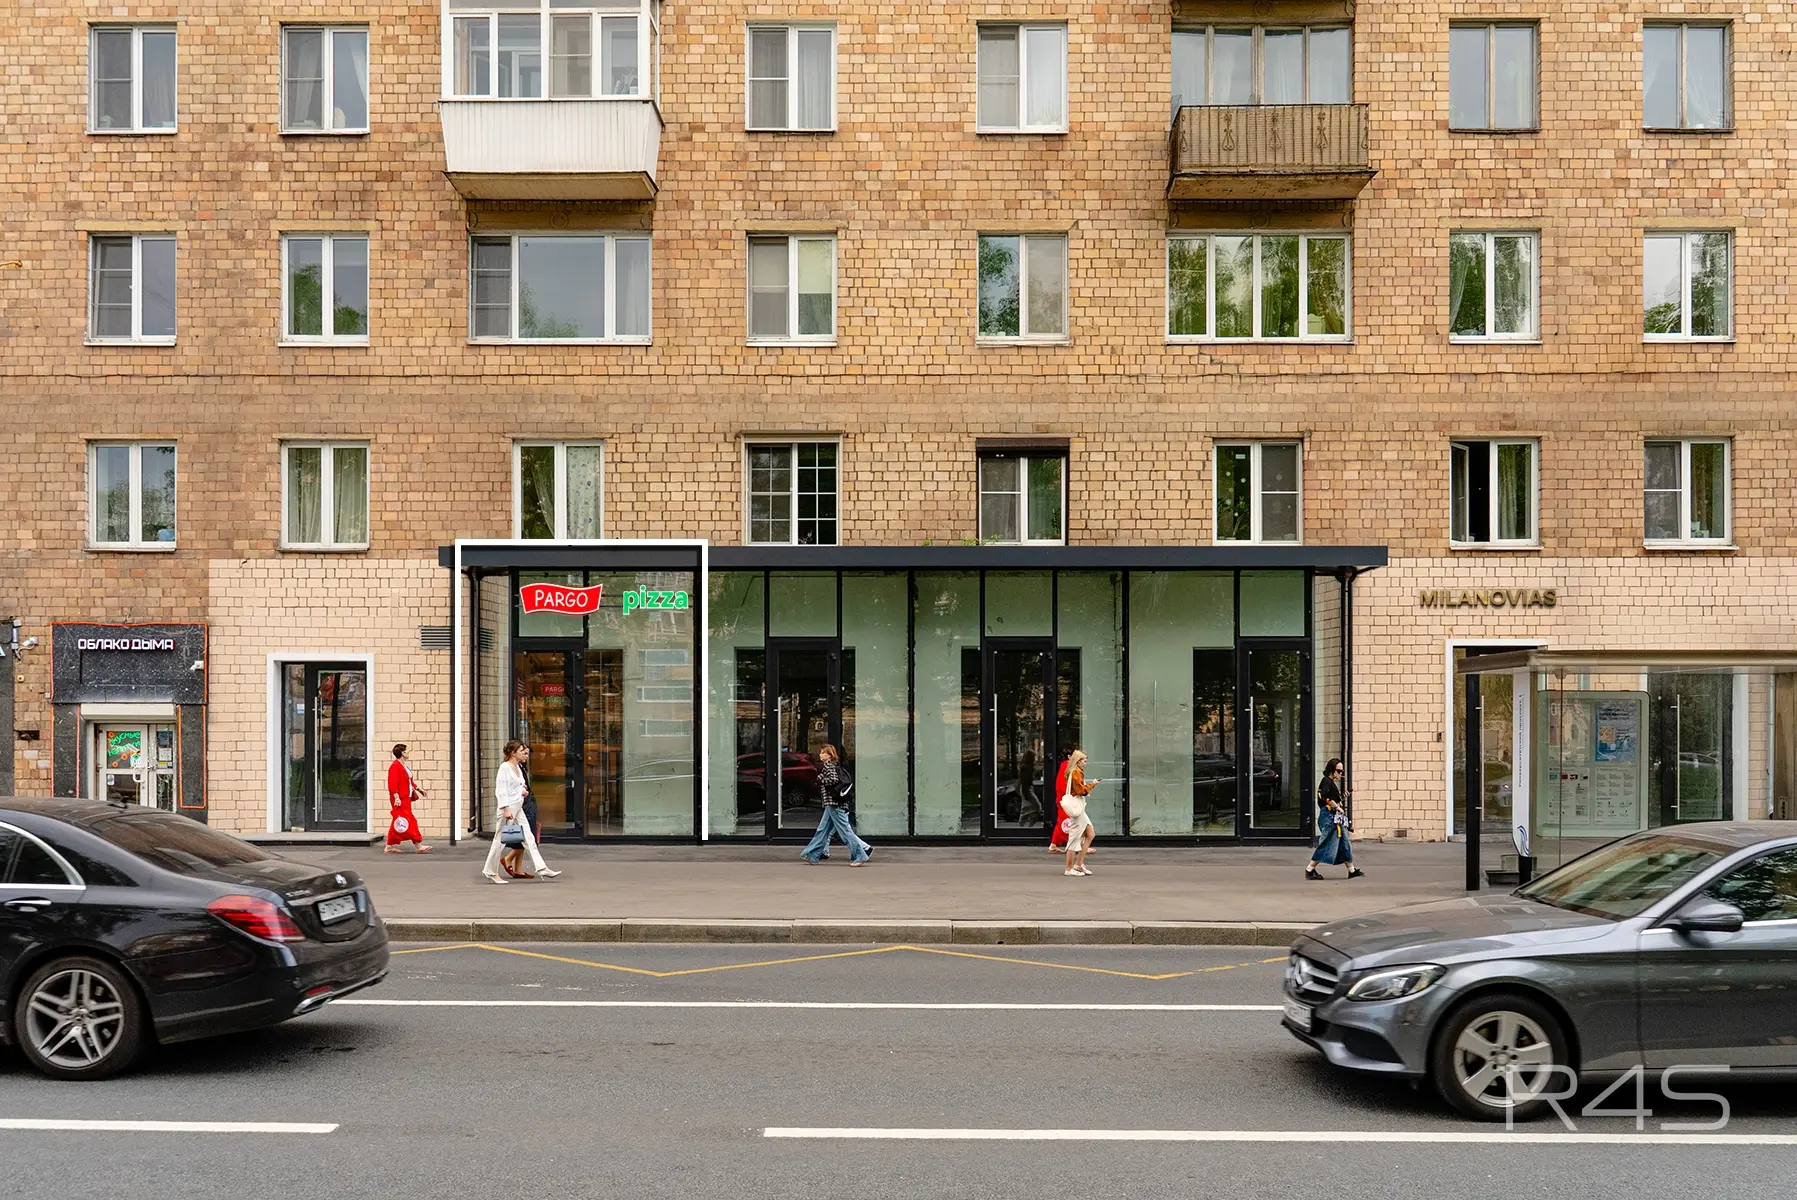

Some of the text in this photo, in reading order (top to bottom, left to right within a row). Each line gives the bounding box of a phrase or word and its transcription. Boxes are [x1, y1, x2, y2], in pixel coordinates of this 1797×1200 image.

[534, 584, 689, 616] PARGO pizza
[1419, 588, 1557, 608] MILANOVIAS
[78, 638, 174, 650] ОБЛАКО ДЫМА
